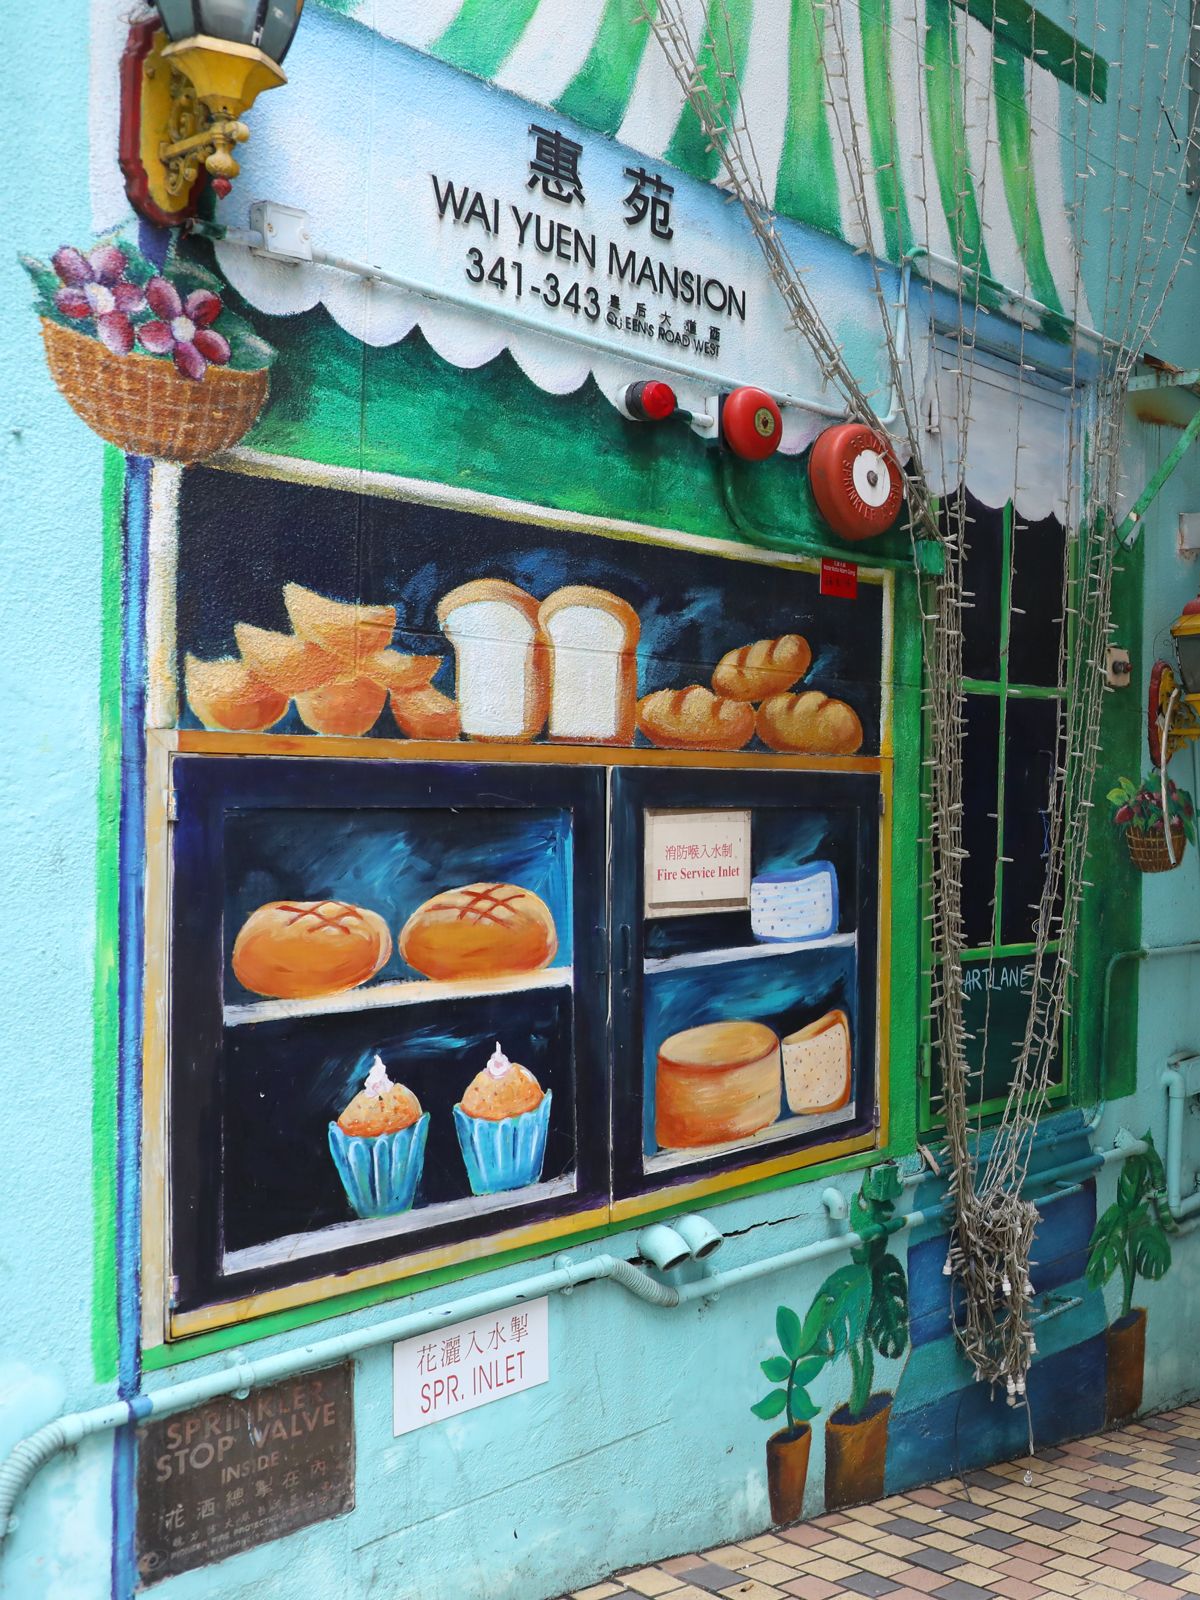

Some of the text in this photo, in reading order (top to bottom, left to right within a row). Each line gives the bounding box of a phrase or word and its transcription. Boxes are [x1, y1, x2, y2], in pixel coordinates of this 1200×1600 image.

[526, 123, 676, 241] 惠苑
[431, 174, 747, 322] WAI YUEN MANSION
[465, 247, 601, 322] 341-343
[608, 294, 721, 342] 皇后大道西
[657, 326, 691, 348] ROAD
[693, 338, 721, 358] WEST
[656, 865, 740, 881] Fire Service Inlet
[664, 842, 733, 861] 消防喉入水制
[416, 1312, 530, 1377] 花灑入水掣
[166, 1380, 326, 1450] SPRINKLER
[420, 1350, 526, 1415] SPR. INLET
[155, 1401, 336, 1483] STOP VALVE
[220, 1450, 281, 1485] INSIDE
